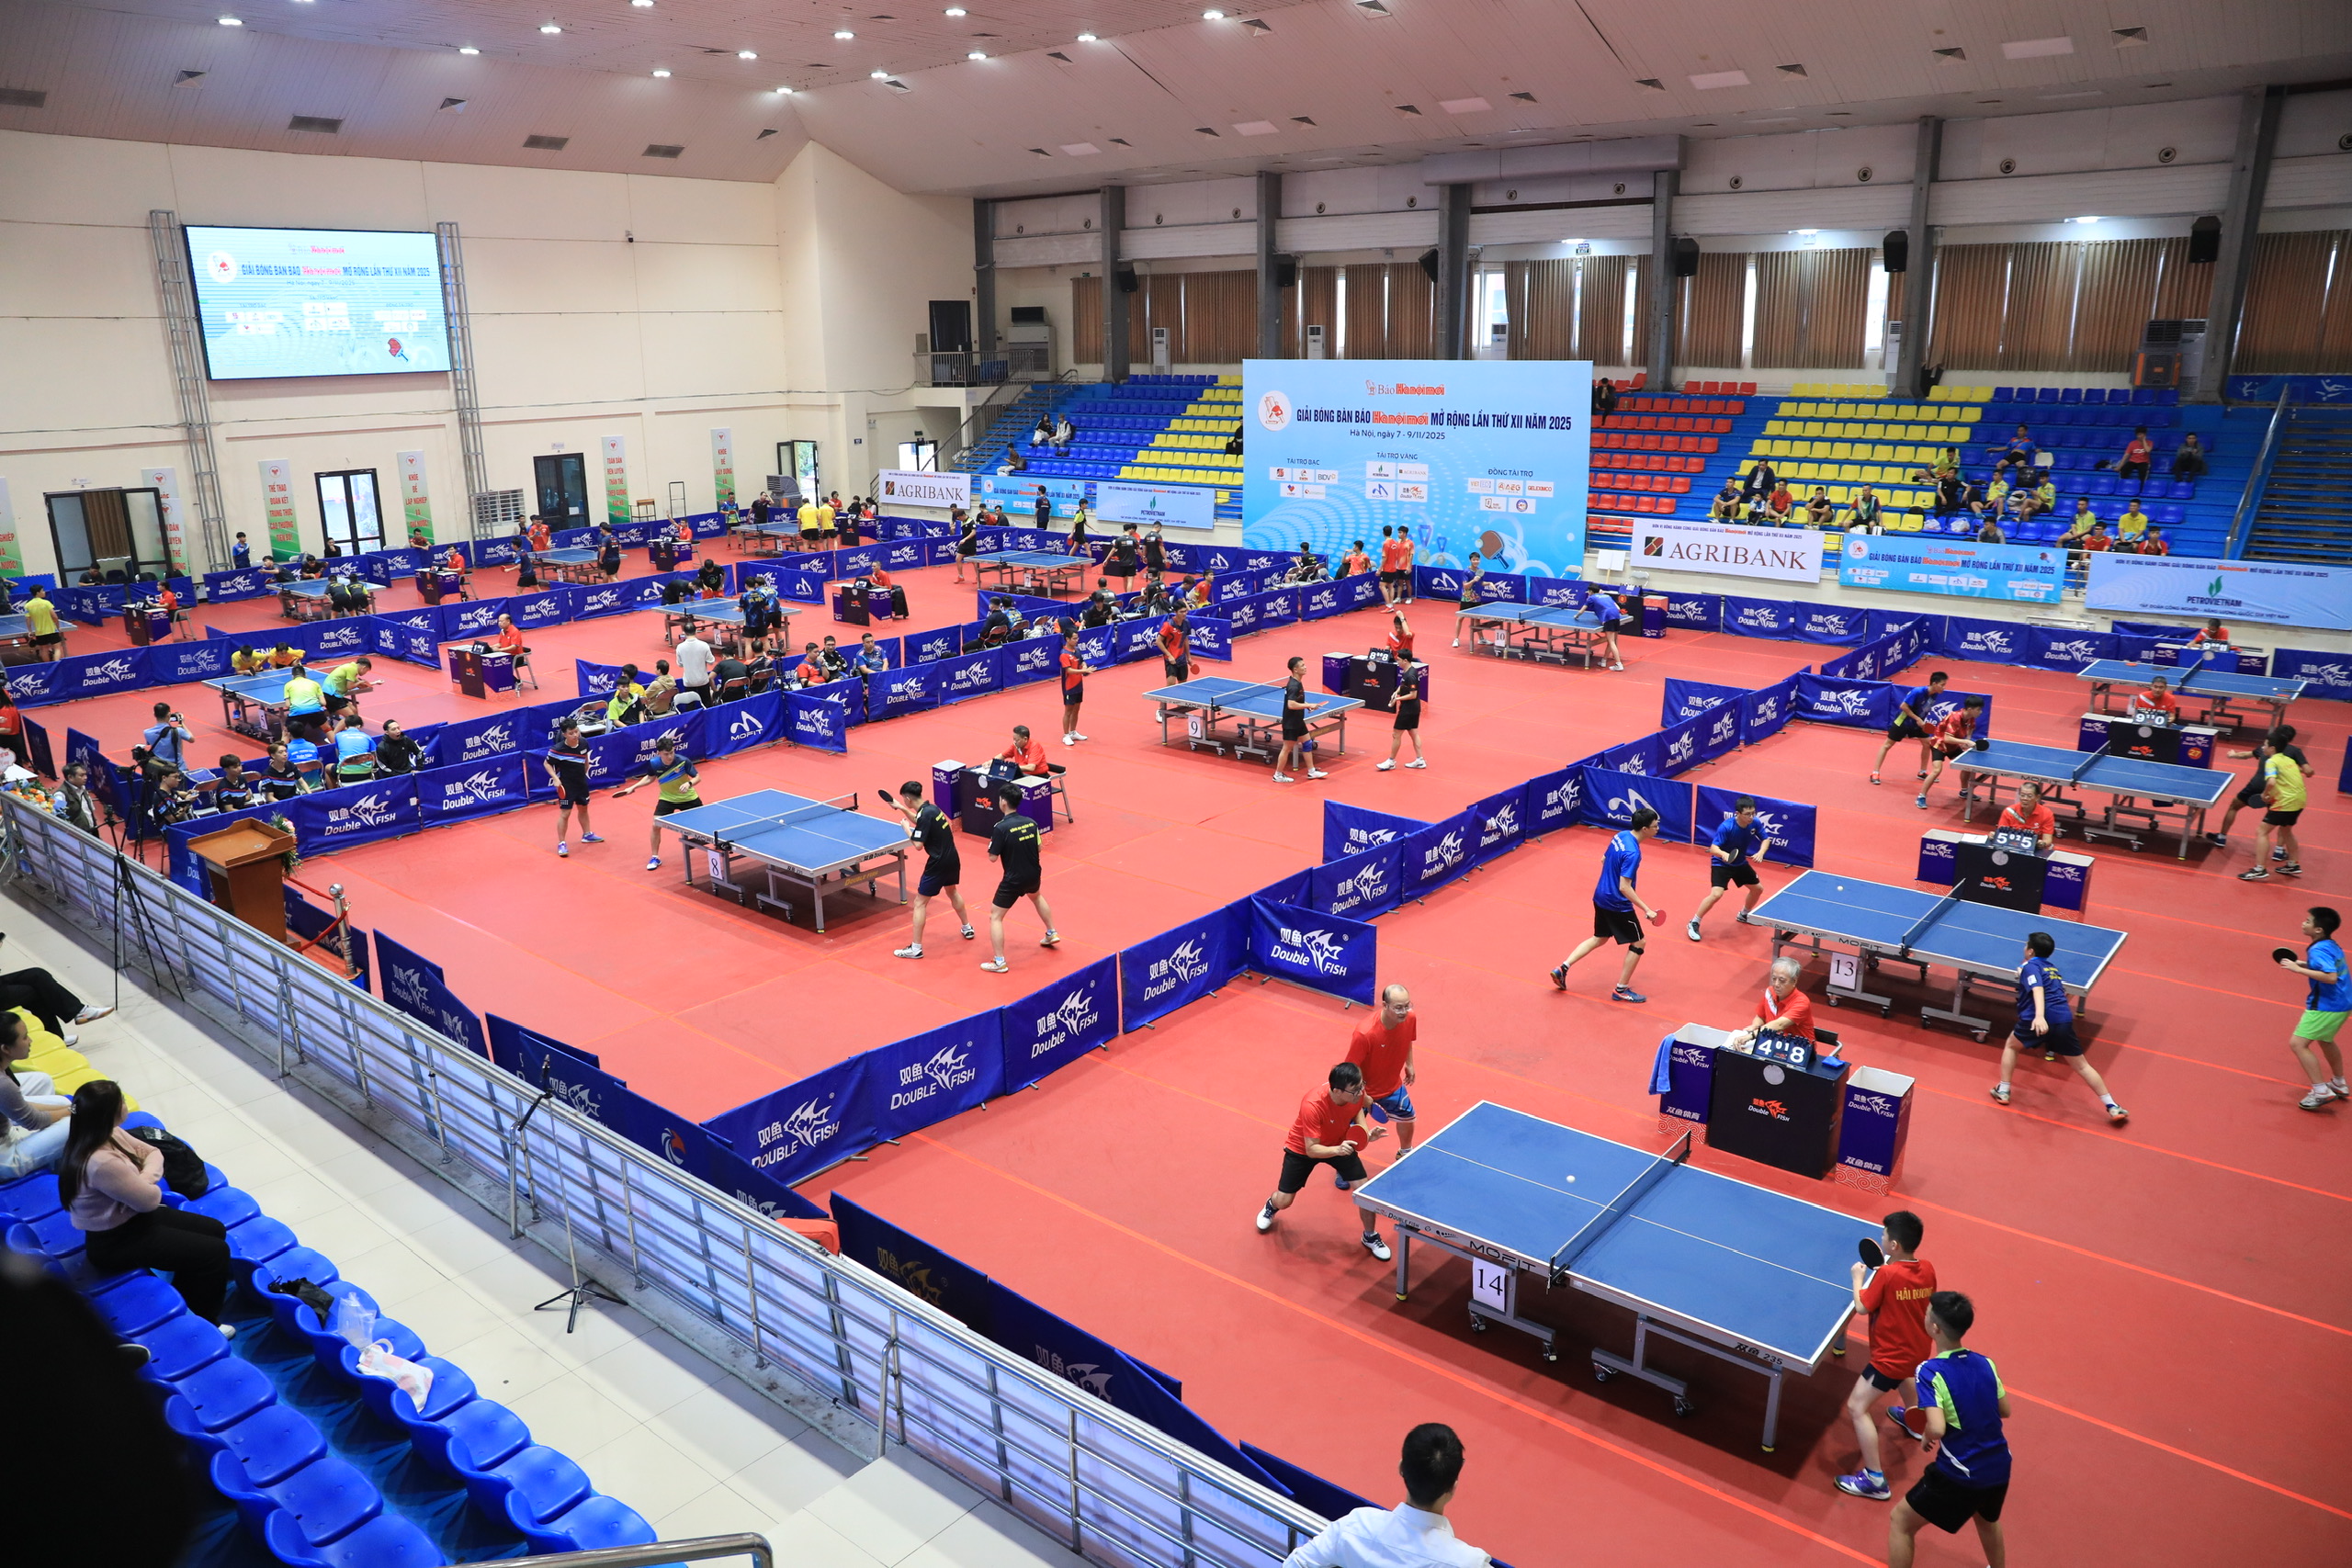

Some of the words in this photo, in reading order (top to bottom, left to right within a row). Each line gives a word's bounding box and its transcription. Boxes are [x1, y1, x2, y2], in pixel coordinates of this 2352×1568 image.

[1378, 384, 1396, 395] Báo
[1296, 405, 1312, 423] GIẢI
[1314, 407, 1334, 423] BÓNG
[1337, 407, 1353, 423] BÀN
[1354, 408, 1371, 423] BÁO
[1430, 408, 1445, 426] MỞ
[1446, 411, 1470, 430] RỘNG
[1472, 410, 1489, 427] LẦN
[1492, 412, 1510, 428] THỨ
[1510, 414, 1522, 429] XII
[1525, 413, 1546, 430] NĂM
[1549, 416, 1571, 430] 2025
[1350, 429, 1360, 437] Hà
[1362, 429, 1376, 438] Nội,
[1376, 430, 1395, 439] ngày
[1407, 431, 1445, 440] 9/11/2025
[1385, 452, 1399, 460] TRỢ
[1400, 452, 1419, 460] VÀNG
[1317, 473, 1330, 481] BIDV
[1487, 467, 1508, 476] ĐỒNG
[897, 485, 964, 501] AGRIBANK
[1668, 542, 1807, 570] AGRIBANK
[1869, 550, 1881, 561] GIẢI
[1881, 553, 1896, 563] BÓNG
[1897, 552, 1910, 564] BÀN
[1910, 554, 1922, 565] BÁO
[1961, 558, 1971, 569] MỞ
[1972, 558, 1988, 571] RỘNG
[1989, 558, 2002, 570] LẦN
[2002, 560, 2015, 571] THỨ
[2024, 562, 2039, 573] NĂM
[2040, 566, 2055, 575] 2025
[2187, 595, 2242, 607] PETROVIETNAM
[715, 632, 721, 646] 6
[1495, 631, 1506, 641] 10
[1369, 651, 1377, 660] 8
[1381, 653, 1389, 661] 8
[1960, 641, 1986, 652] Double
[1996, 645, 2012, 655] FISH
[82, 674, 110, 688] Double
[120, 671, 136, 681] FISH
[1813, 702, 1842, 714] Double
[1851, 707, 1871, 716] FISH
[260, 713, 266, 727] 5
[2135, 713, 2145, 722] 9
[2154, 716, 2165, 725] 0
[730, 728, 763, 741] MOFIT
[1191, 720, 1198, 735] 9
[462, 747, 490, 761] Double
[500, 740, 517, 751] FISH
[2188, 749, 2201, 757] 27
[2020, 773, 2061, 785] MOFIT
[442, 794, 475, 811] Double
[487, 787, 506, 799] FISH
[323, 819, 362, 837] Double
[375, 812, 397, 825] FISH
[1996, 832, 2008, 844] 5
[2020, 836, 2032, 848] 5
[710, 857, 719, 876] 8
[1420, 862, 1446, 882] Double
[1452, 849, 1464, 865] FISH
[1331, 896, 1361, 916] Double
[1371, 883, 1388, 899] FISH
[1838, 937, 1882, 951] MOFIT
[1271, 945, 1310, 966] Double
[1324, 961, 1347, 976] FISH
[1833, 959, 1854, 977] 13
[1143, 976, 1177, 1002] Double
[1189, 962, 1208, 980] FISH
[1031, 1032, 1065, 1059] Double
[1079, 1011, 1099, 1032] FISH
[1758, 1039, 1772, 1055] 4
[1775, 1041, 1782, 1049] 0
[1784, 1042, 1790, 1051] 1
[1790, 1046, 1805, 1064] 8
[1696, 1061, 1710, 1069] FISH
[890, 1082, 937, 1111] DOUBLE
[950, 1067, 976, 1088] FISH
[1747, 1105, 1770, 1116] Double
[1777, 1113, 1791, 1122] FISH
[1848, 1101, 1871, 1112] Double
[1880, 1110, 1895, 1119] FISH
[751, 1140, 798, 1168] DOUBLE
[812, 1121, 840, 1145] FISH
[1387, 1212, 1408, 1224] DOUBLE
[1470, 1240, 1536, 1271] MOFIT
[1477, 1268, 1504, 1297] 14
[1895, 1287, 1911, 1301] HẢI
[1763, 1353, 1784, 1366] 235
